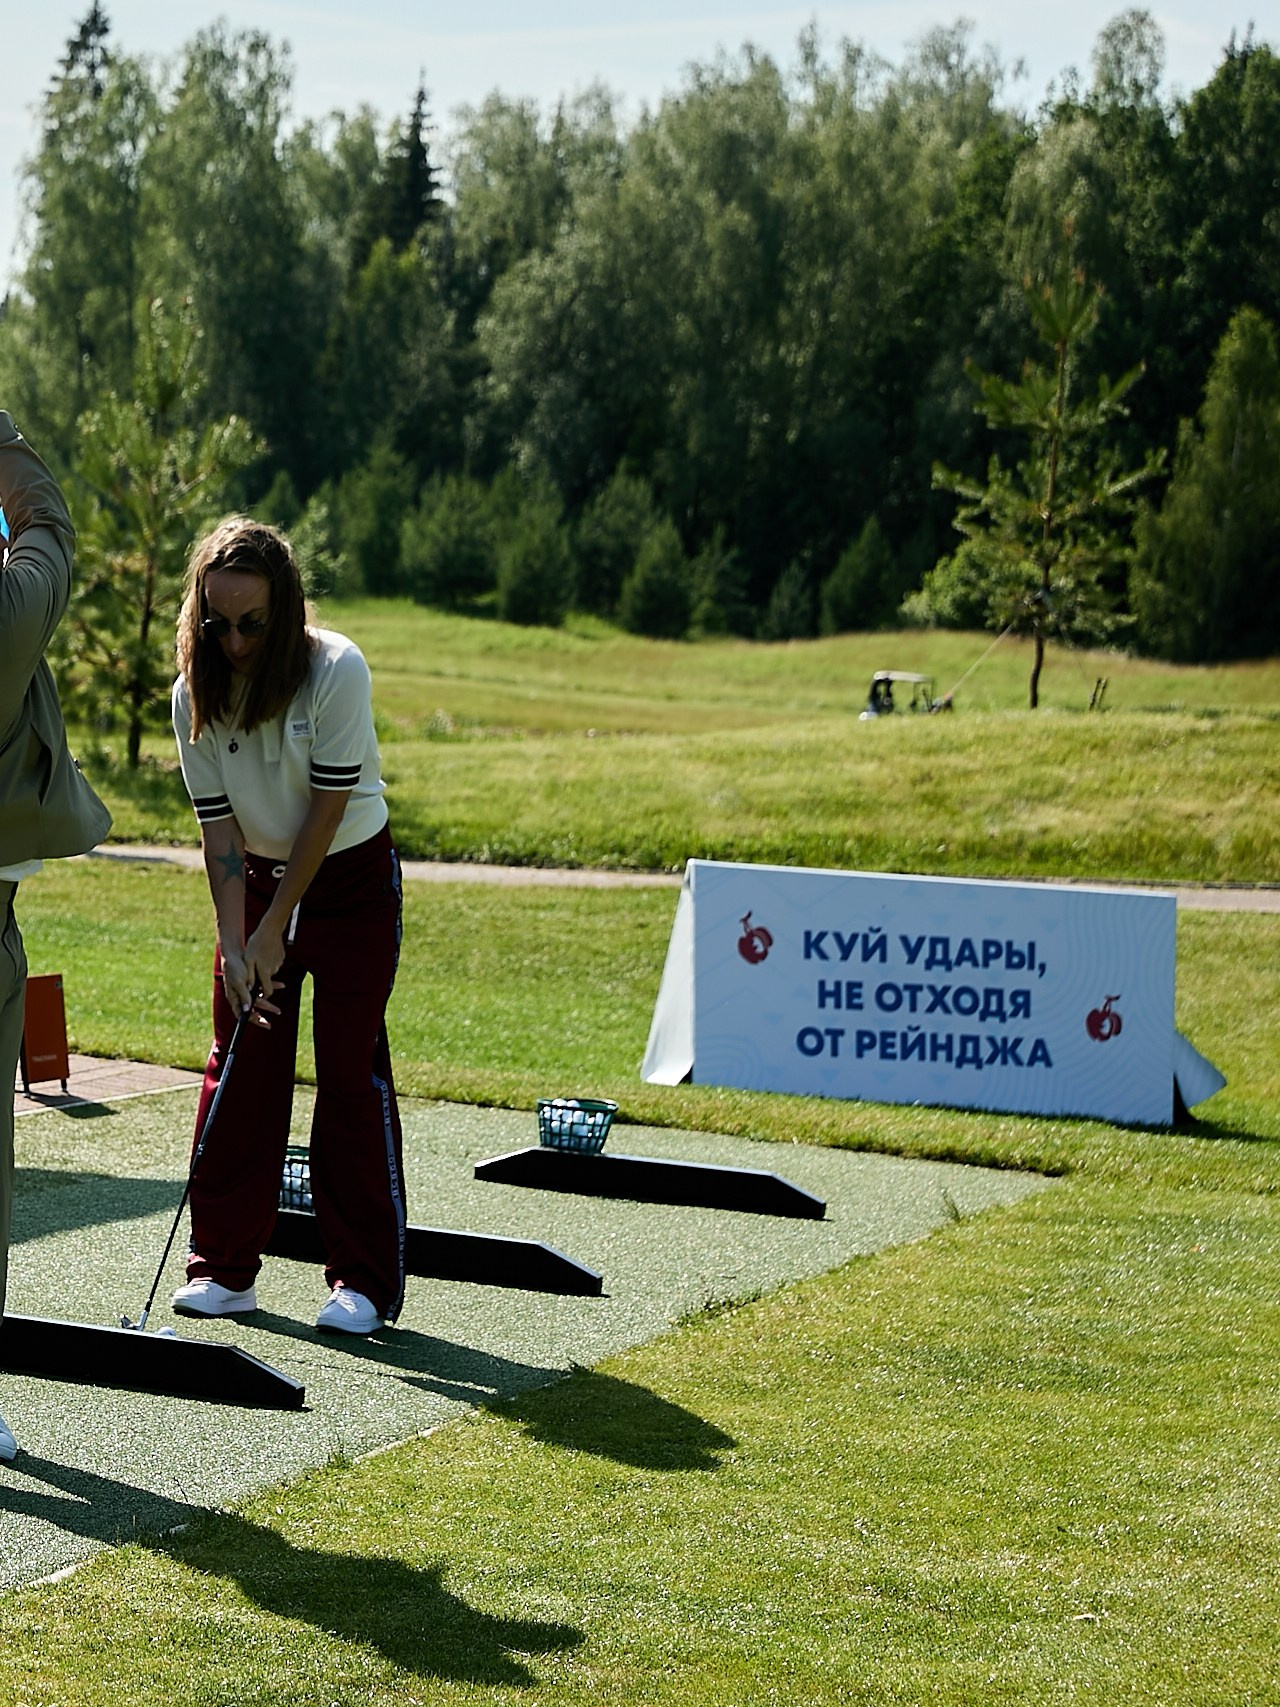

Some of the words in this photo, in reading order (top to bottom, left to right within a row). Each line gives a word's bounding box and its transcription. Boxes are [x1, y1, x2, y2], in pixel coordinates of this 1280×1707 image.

[803, 926, 888, 964] КУЙ
[899, 935, 1047, 978] УДАРЫ,
[817, 979, 864, 1011] НЕ
[875, 982, 1032, 1023] ОТХОДЯ
[796, 1026, 846, 1058] ОТ
[856, 1025, 1054, 1071] РЕЙНДЖА
